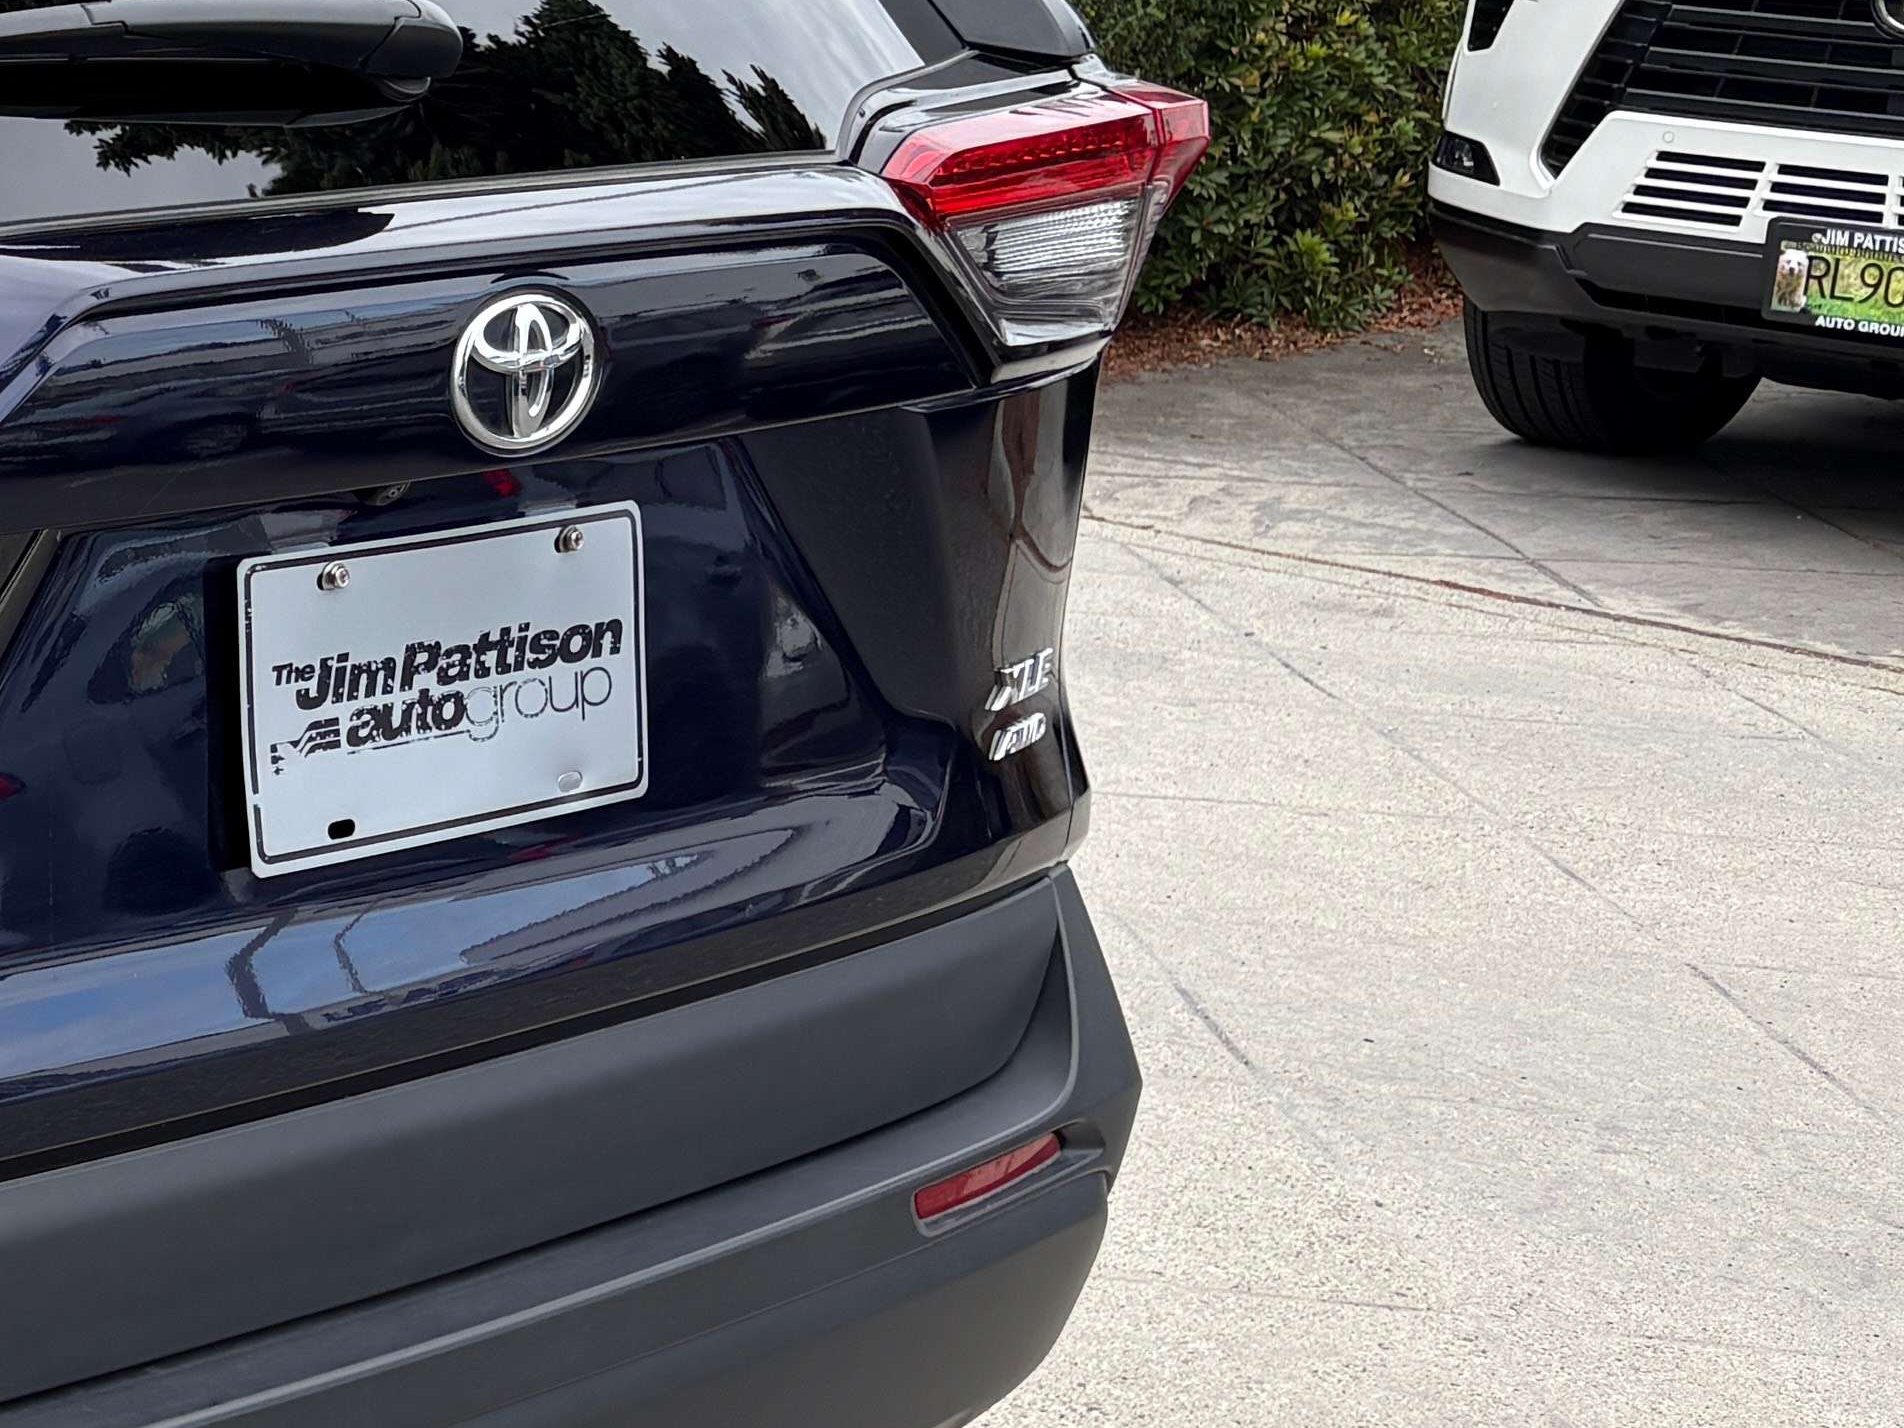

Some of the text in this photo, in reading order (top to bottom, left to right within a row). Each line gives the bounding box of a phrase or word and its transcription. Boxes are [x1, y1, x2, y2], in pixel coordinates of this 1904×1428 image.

[1821, 228, 1850, 247] JIM
[1815, 315, 1855, 331] AUTO
[272, 661, 316, 686] The
[984, 647, 1053, 711] XLE
